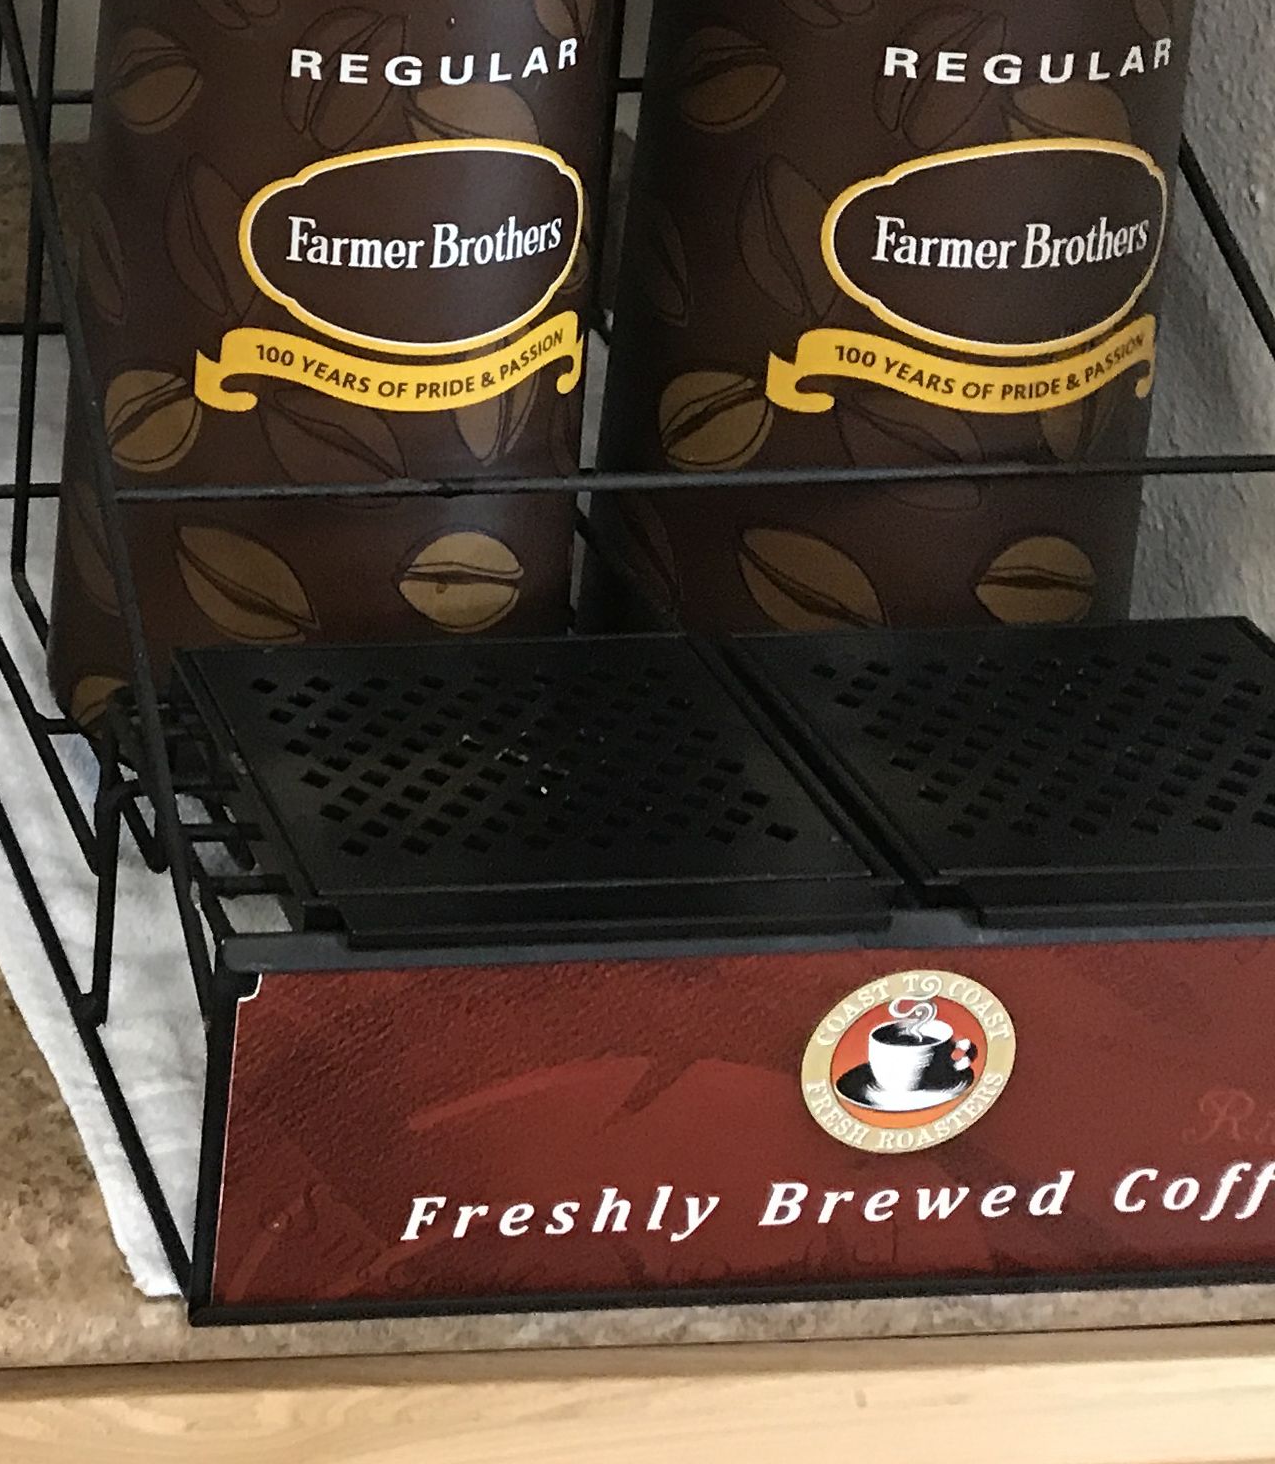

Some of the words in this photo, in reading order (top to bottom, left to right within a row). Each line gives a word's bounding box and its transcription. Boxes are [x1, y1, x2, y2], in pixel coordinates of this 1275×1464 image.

[289, 37, 579, 86] REGULAR
[883, 36, 1172, 85] REGULAR
[285, 215, 425, 270] Farmer
[429, 215, 563, 269] Brothers
[872, 215, 1017, 270] Farmer
[1021, 215, 1150, 270] Brothers
[255, 344, 295, 368] 100
[302, 355, 371, 394] YEARS
[377, 381, 408, 400] OF
[415, 377, 475, 400] PRIDE
[480, 370, 497, 387] &
[500, 327, 564, 382] PASSION
[834, 344, 876, 369] 100
[884, 356, 955, 395] YEARS
[961, 381, 994, 401] OF
[1000, 379, 1060, 401] PRIDE
[1065, 373, 1082, 390] &
[1084, 334, 1145, 384] PASSION
[814, 981, 890, 1046] COAST
[948, 980, 1012, 1040] COAST
[806, 1079, 870, 1145] FRESH
[873, 1073, 1003, 1149] ROASTERS
[400, 1185, 722, 1243] Freshly
[758, 1169, 1076, 1226] Brewed
